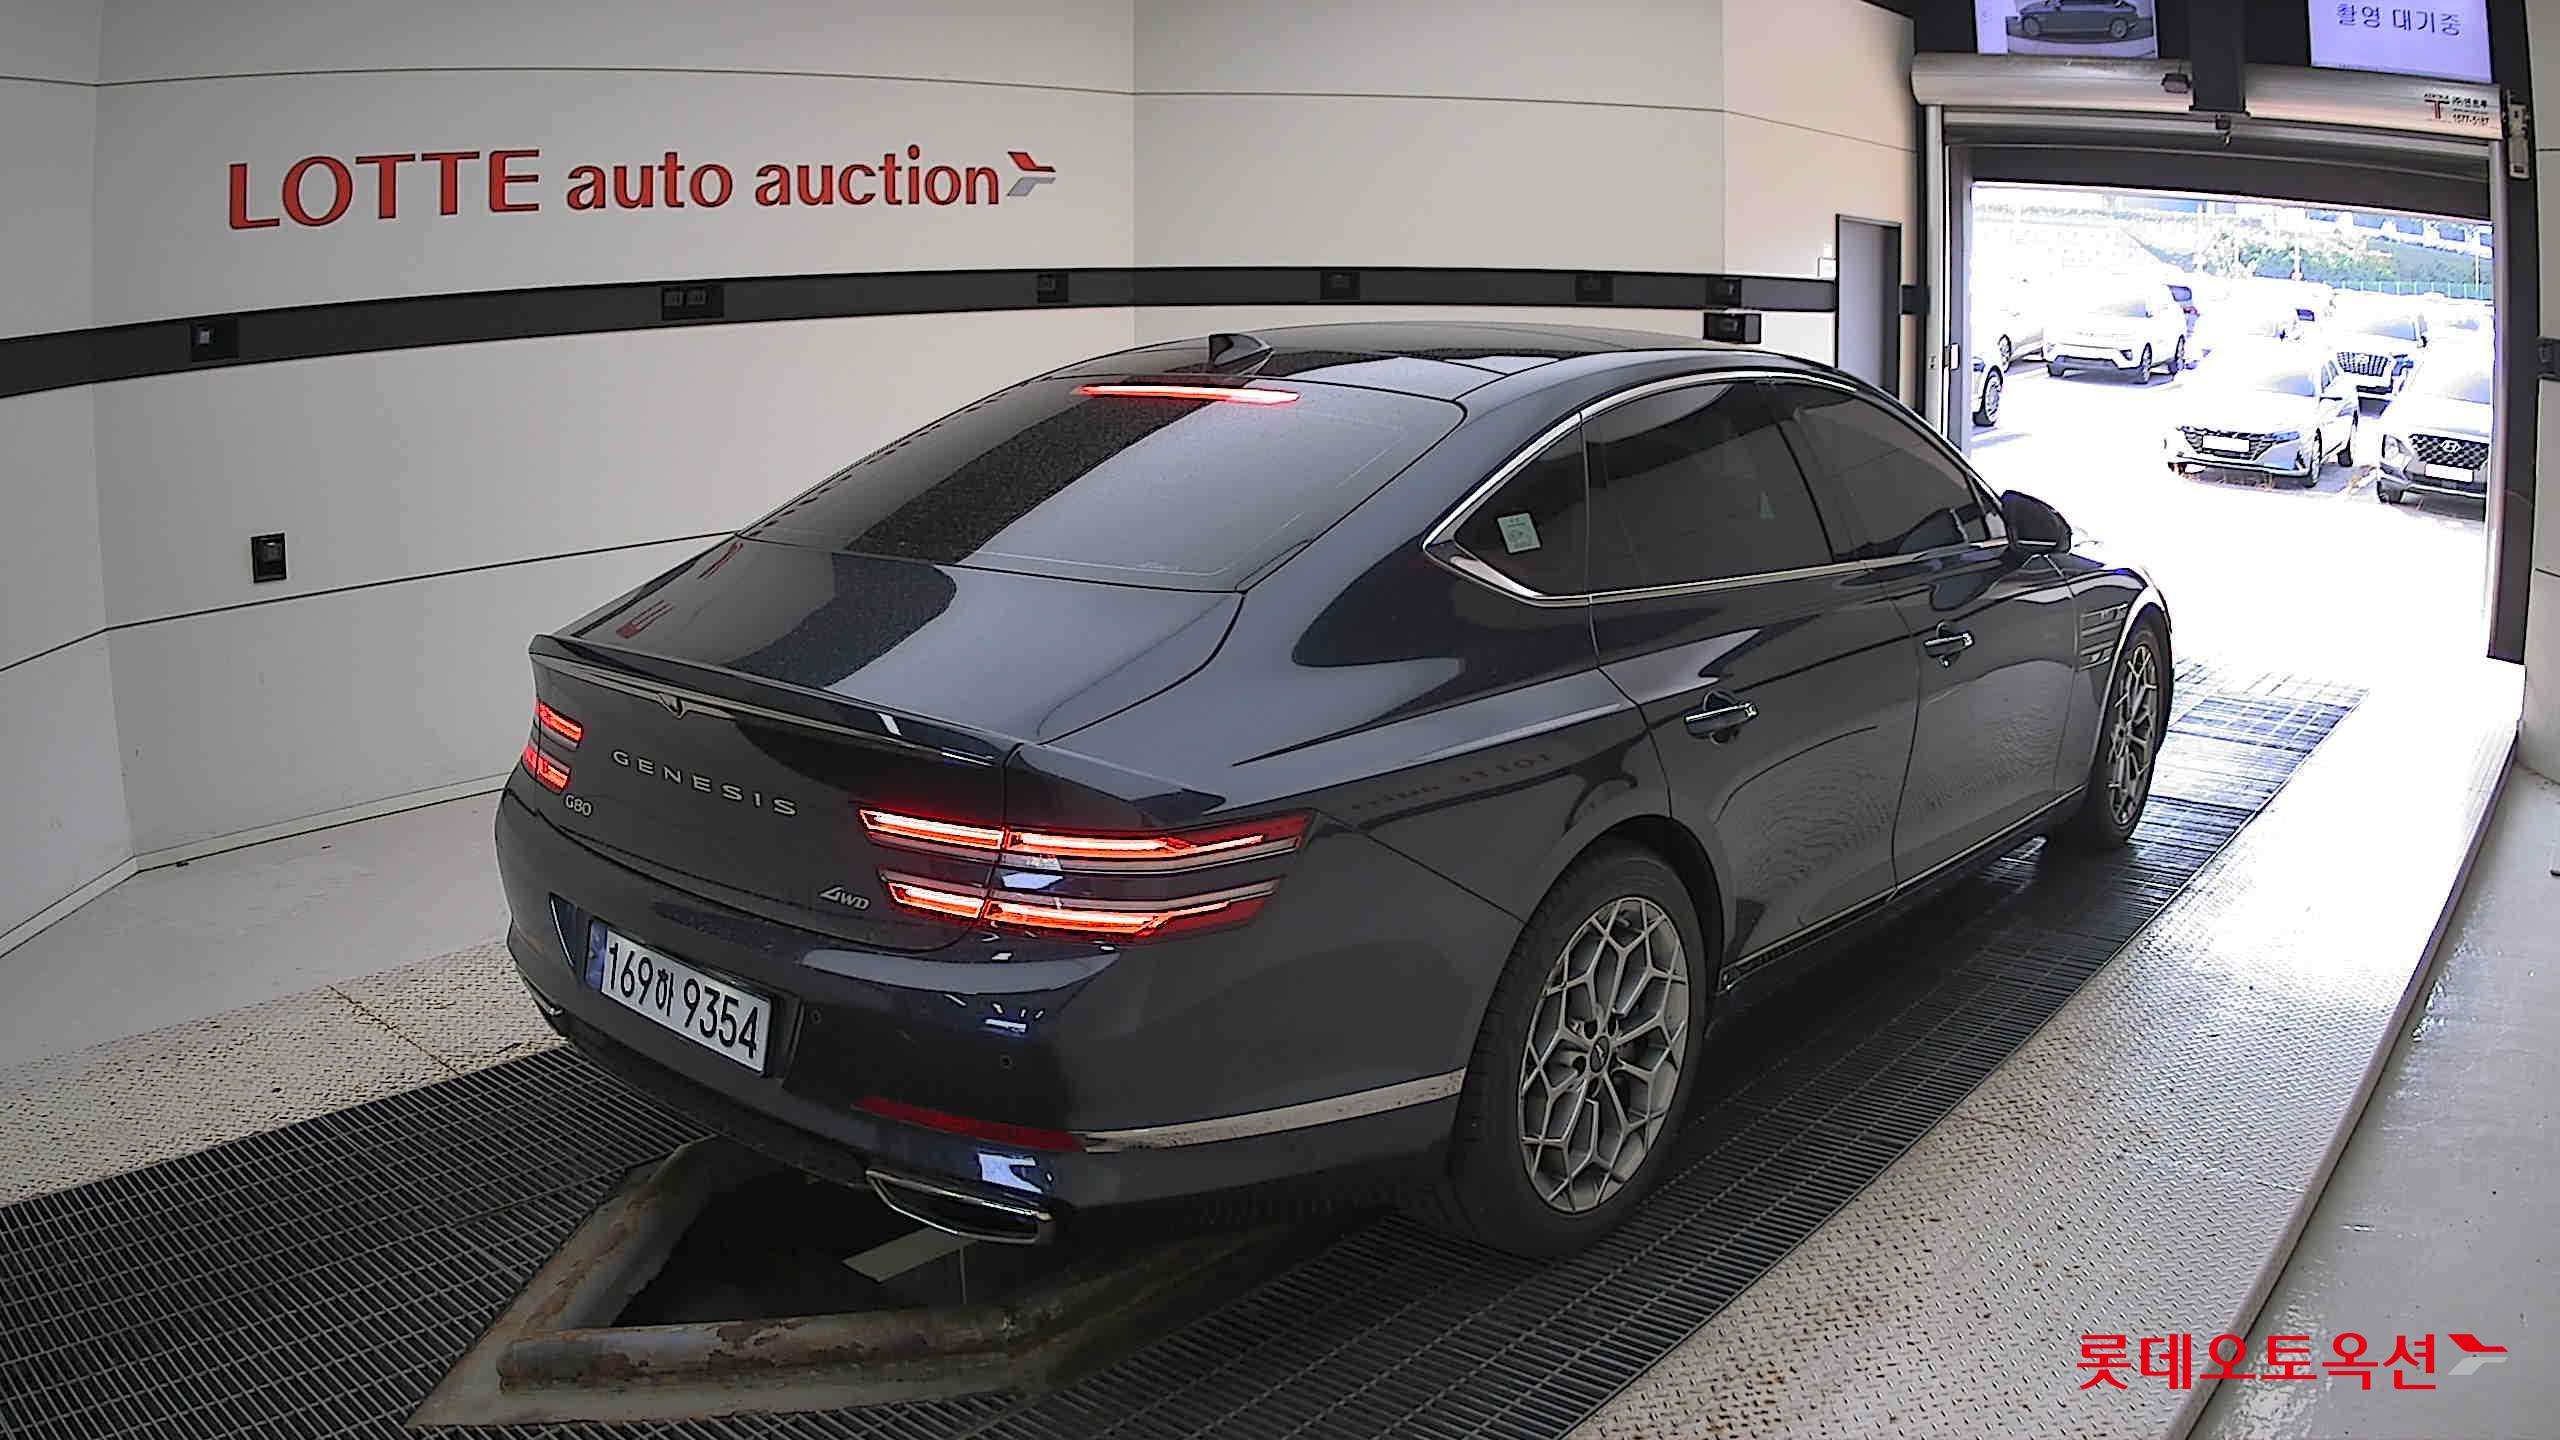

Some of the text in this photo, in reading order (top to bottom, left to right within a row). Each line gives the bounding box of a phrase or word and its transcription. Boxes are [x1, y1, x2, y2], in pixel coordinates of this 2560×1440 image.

[2392, 9, 2460, 36] 대기중
[229, 144, 1000, 230] LOTTE auto auction
[565, 794, 593, 816] G80
[612, 750, 797, 816] GENESIS
[683, 978, 759, 1059] 9354
